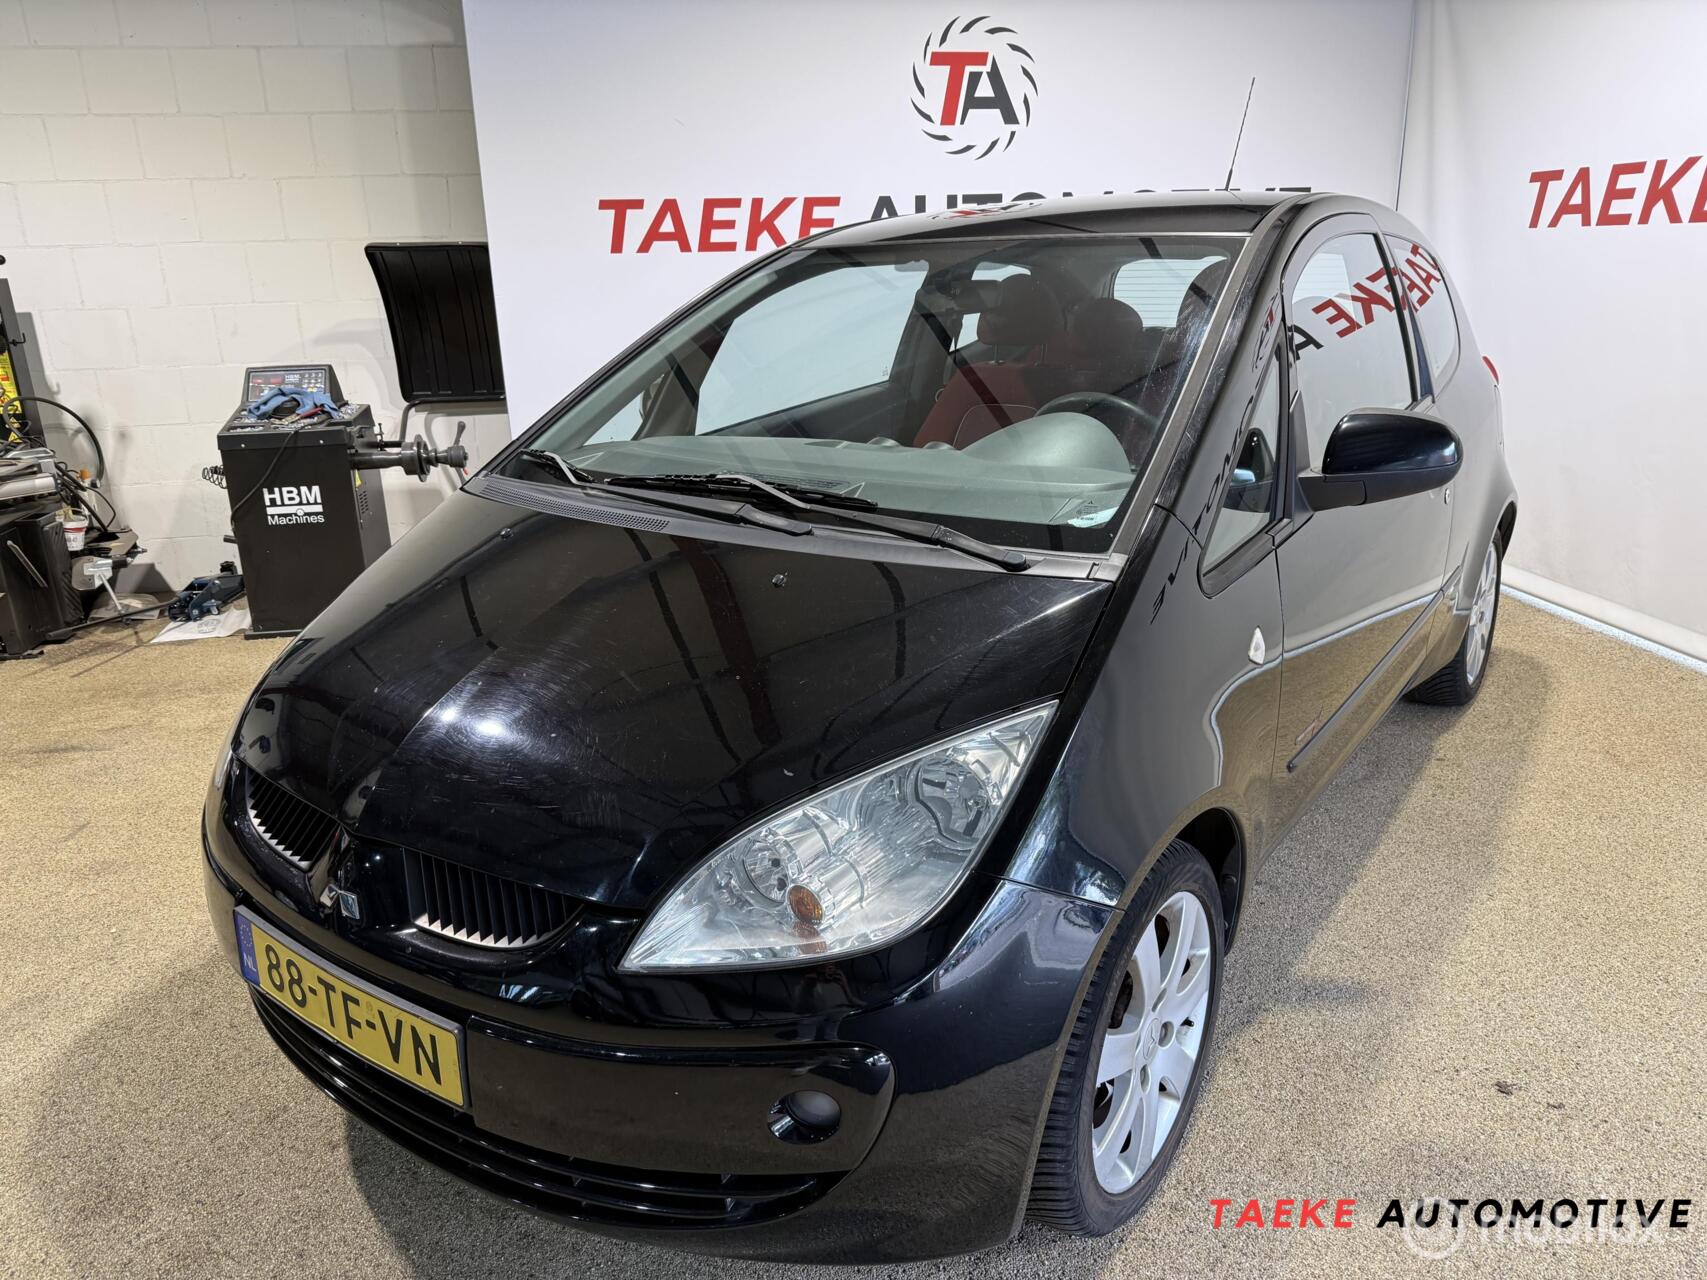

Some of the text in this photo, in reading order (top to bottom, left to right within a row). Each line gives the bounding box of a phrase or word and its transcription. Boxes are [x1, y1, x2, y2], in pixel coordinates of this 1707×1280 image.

[929, 51, 1020, 126] TA
[262, 485, 322, 506] HBM
[267, 514, 325, 526] Machines
[243, 952, 256, 972] NL
[265, 943, 442, 1086] 88-TF-VN
